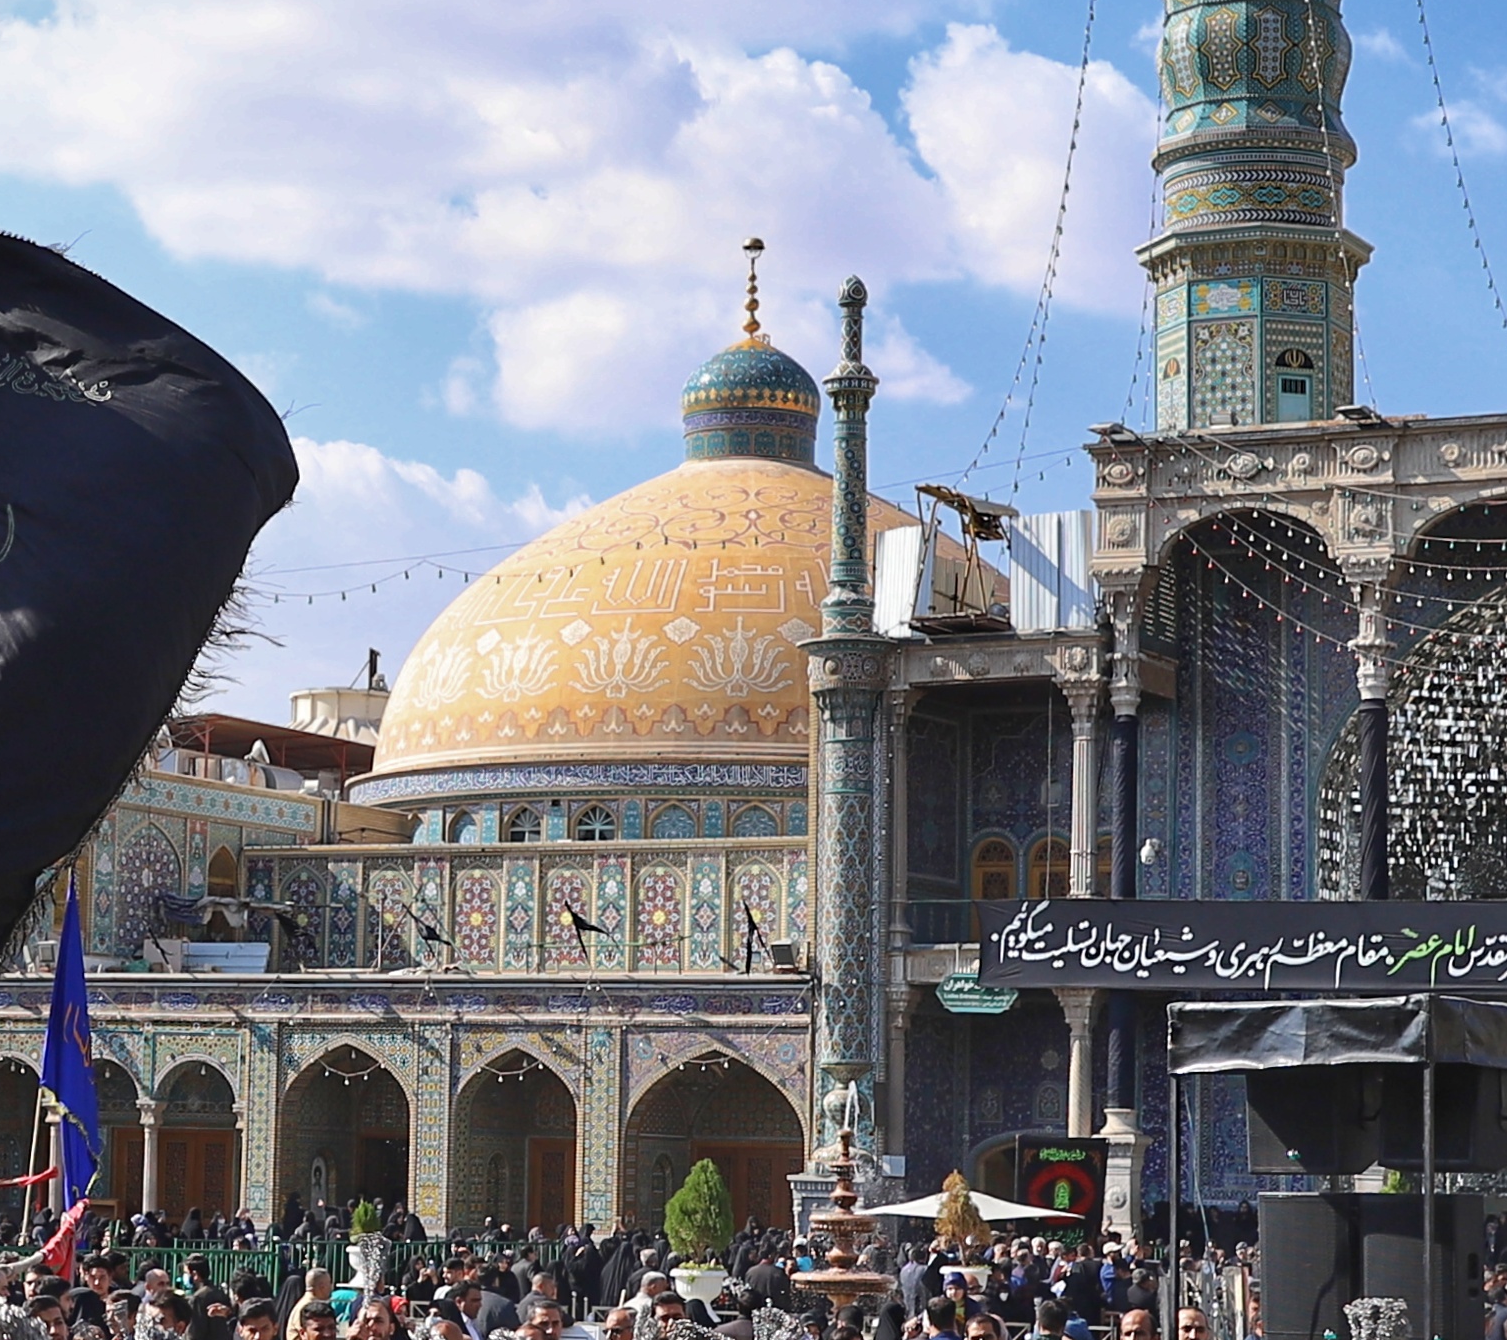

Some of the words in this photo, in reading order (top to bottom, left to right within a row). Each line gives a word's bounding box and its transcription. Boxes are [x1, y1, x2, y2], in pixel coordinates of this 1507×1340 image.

[1022, 920, 1097, 968] تسلیت
[1080, 923, 1132, 967] جهان
[1113, 927, 1219, 978] شیعیان
[1204, 946, 1219, 966] و
[1215, 937, 1284, 979] رهبری
[1335, 933, 1390, 989] مقام
[1431, 924, 1476, 989] امام
